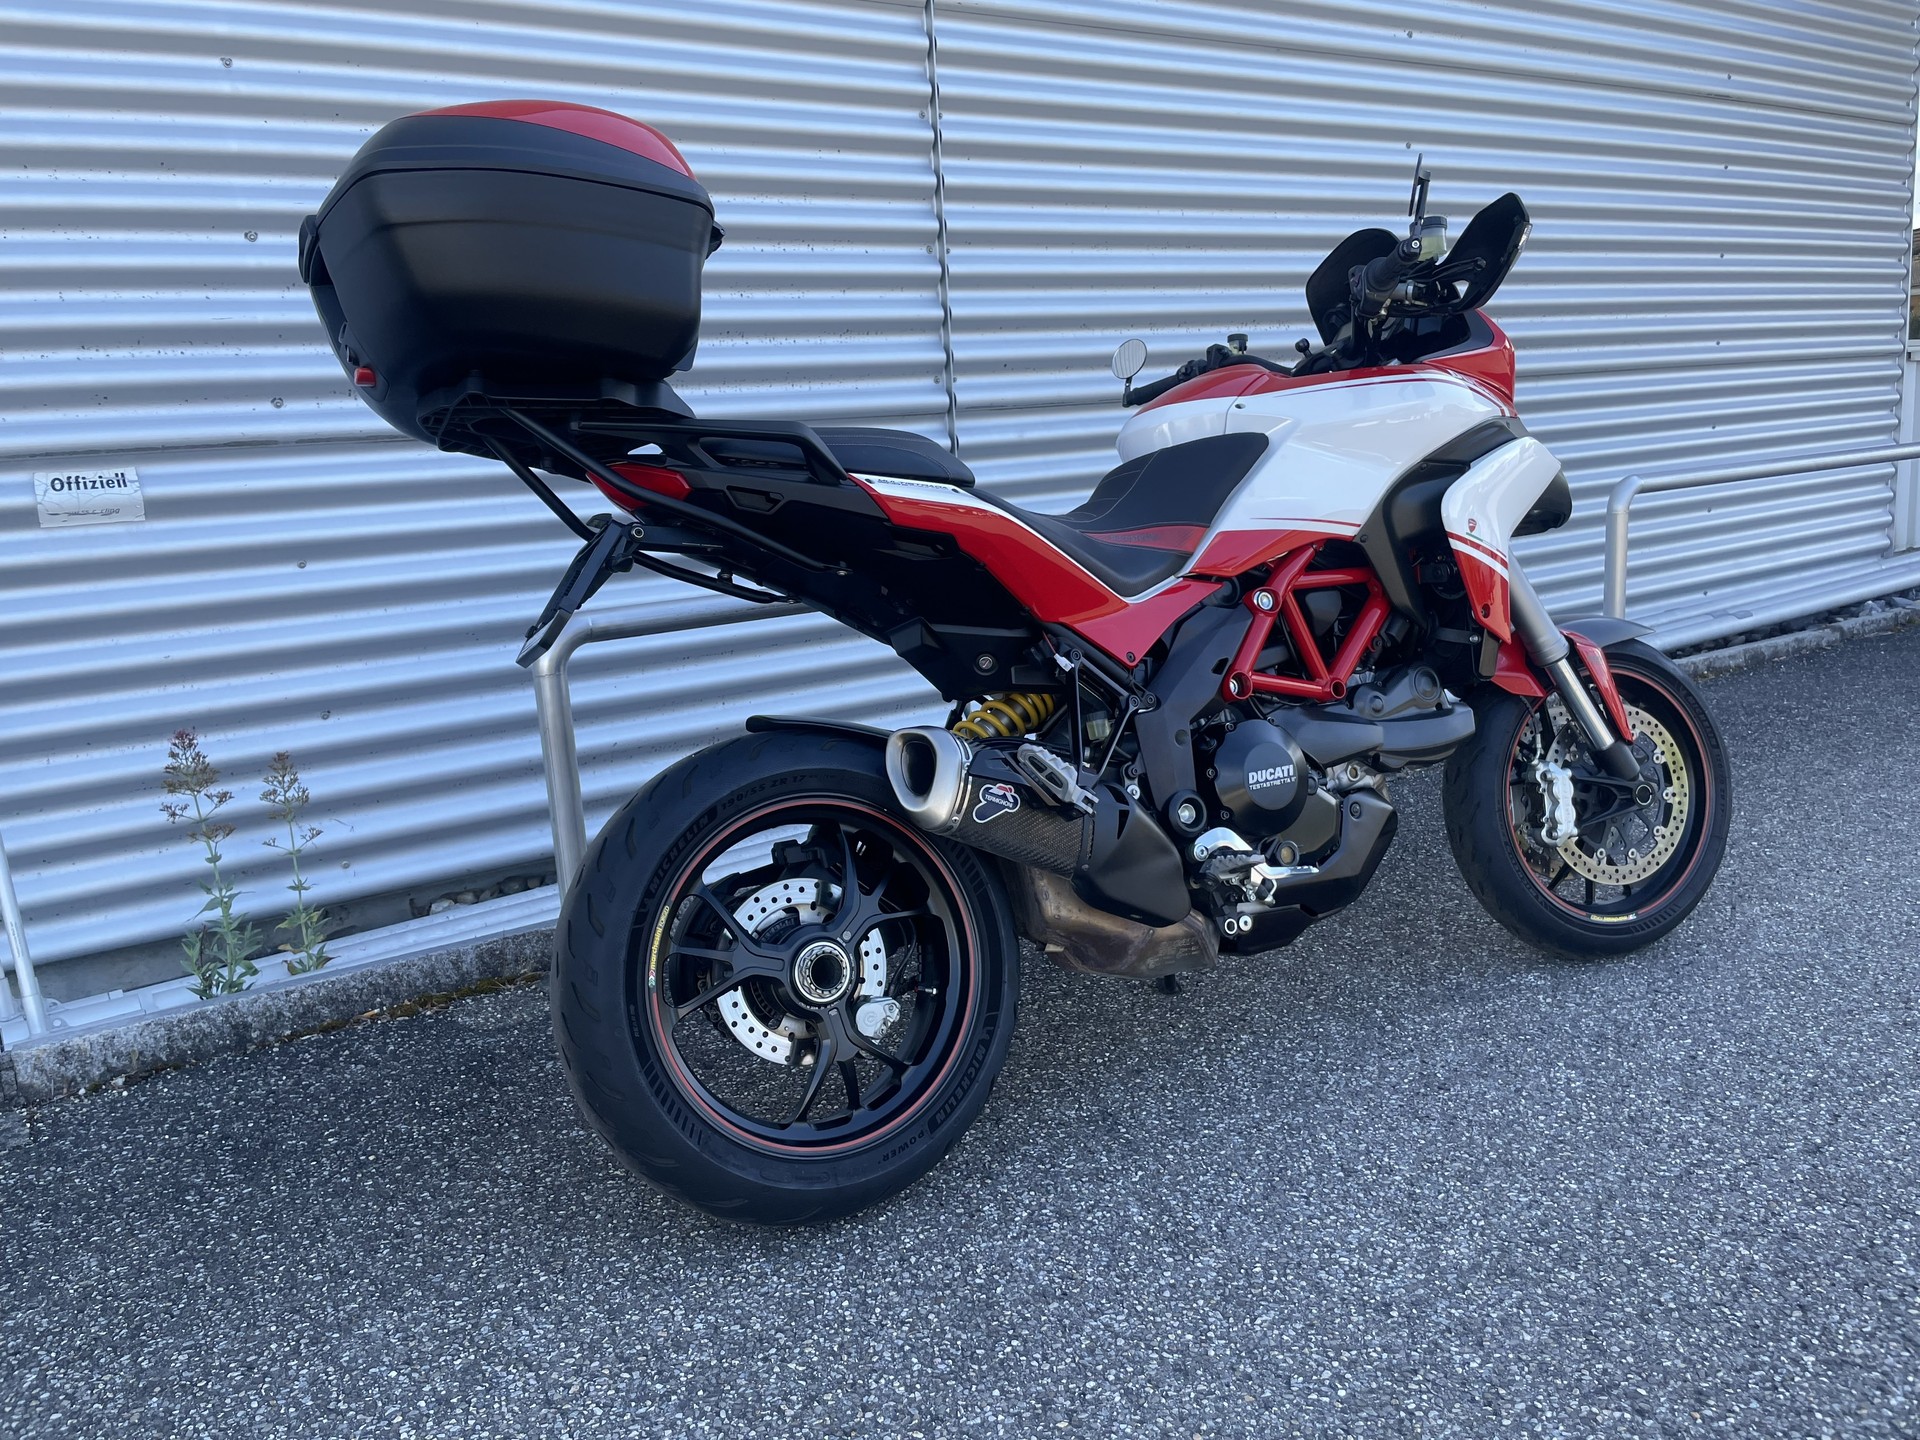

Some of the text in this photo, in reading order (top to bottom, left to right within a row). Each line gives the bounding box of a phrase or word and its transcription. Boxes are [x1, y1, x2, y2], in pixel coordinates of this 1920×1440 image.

[50, 472, 128, 492] Offiziell
[1248, 764, 1294, 785] DUCATI
[1249, 777, 1291, 791] TESTASTRETTA
[649, 814, 711, 894] MICHELIN
[934, 1041, 987, 1126] MICHELIN
[882, 1130, 925, 1162] POWER
